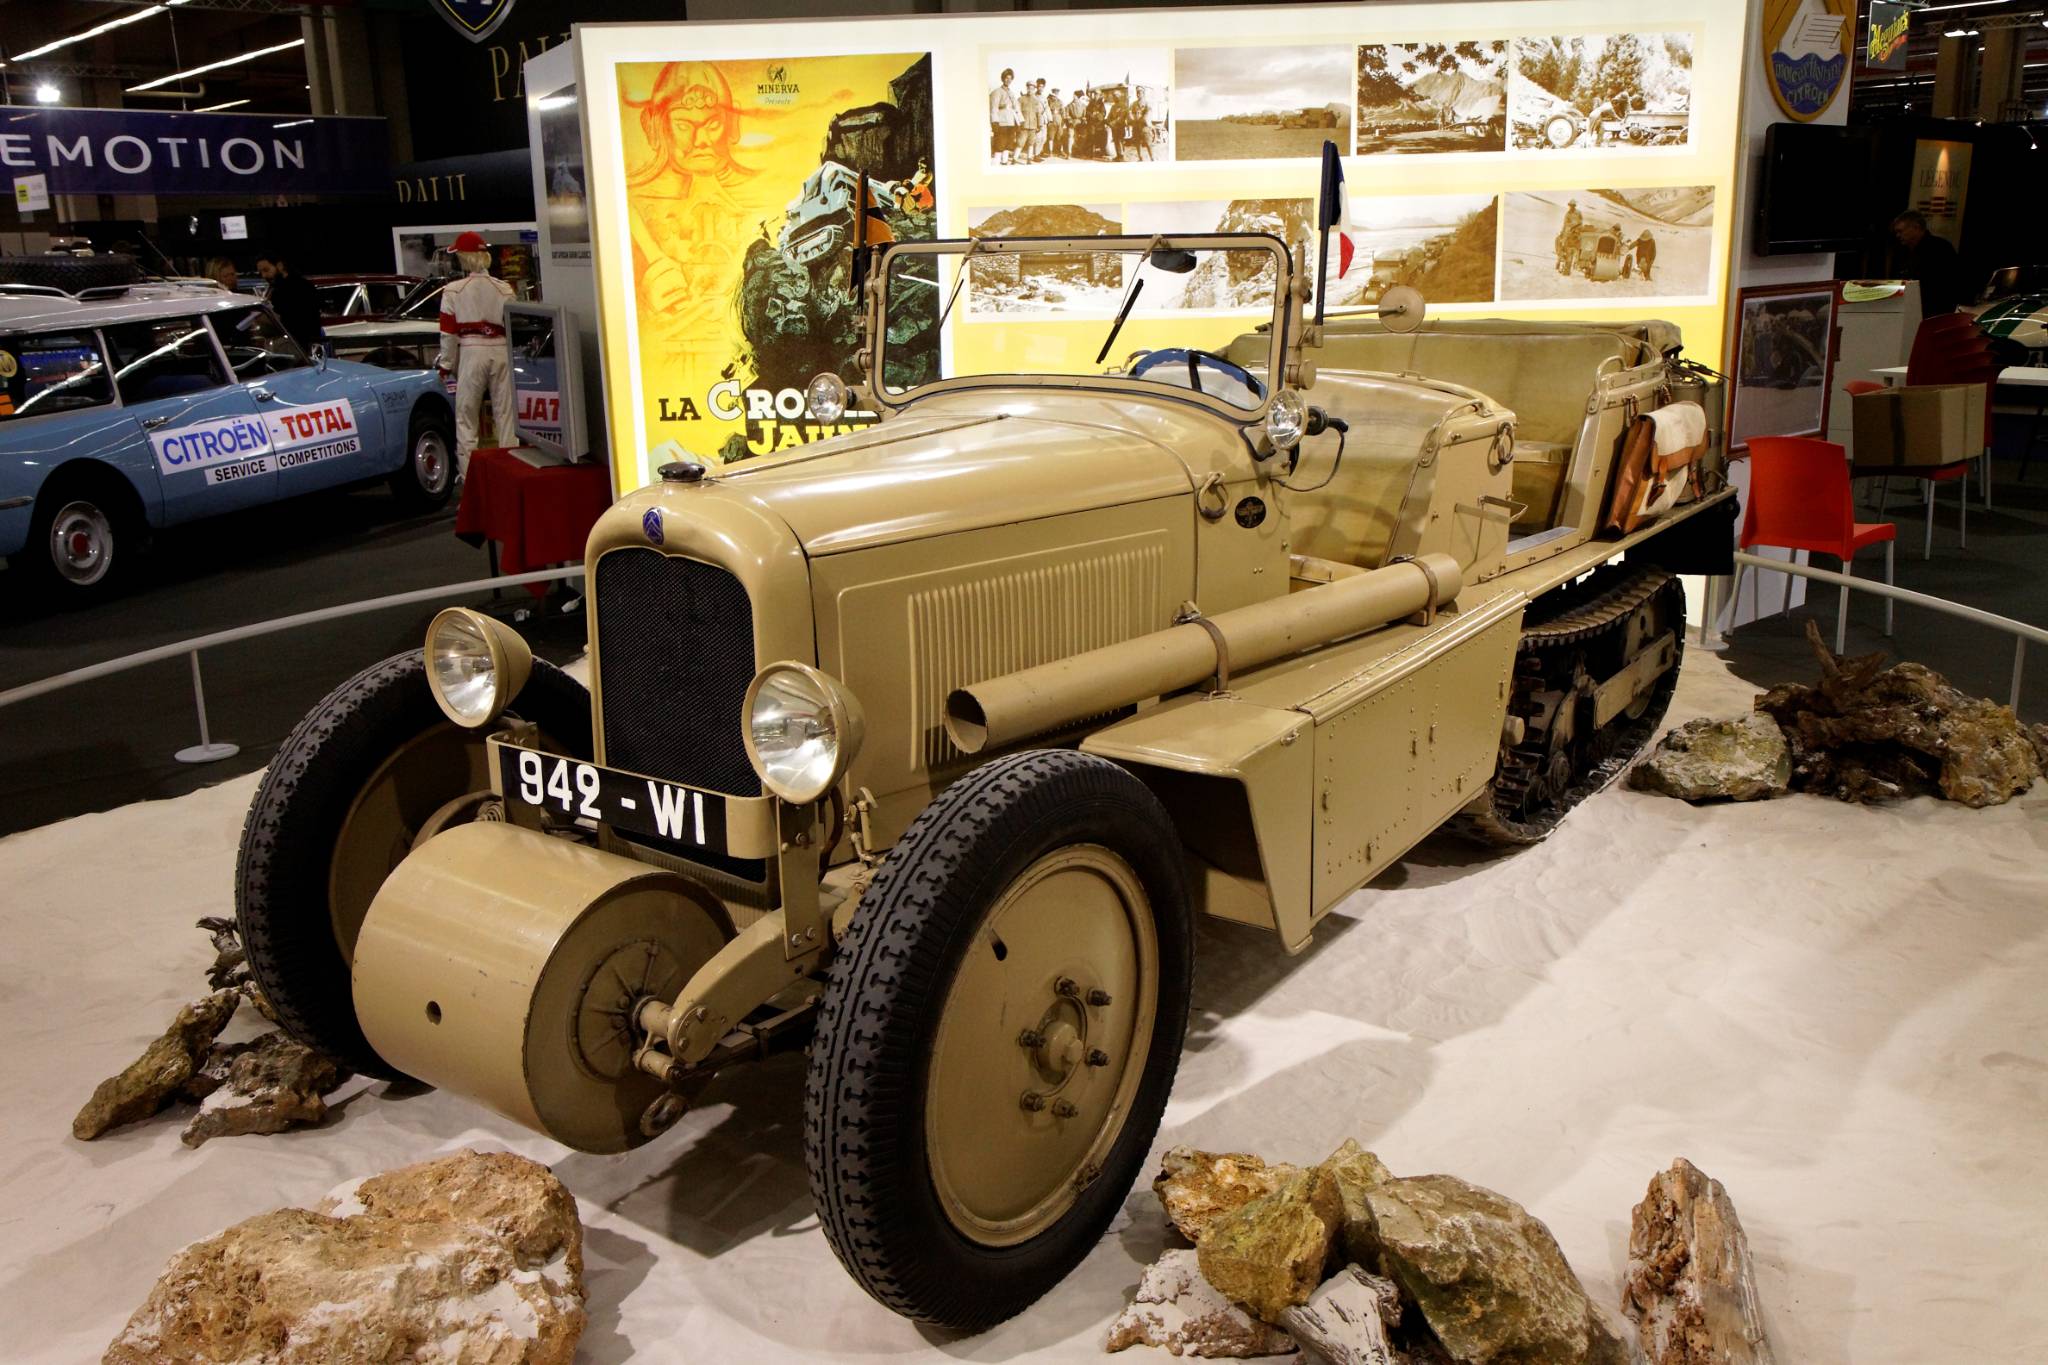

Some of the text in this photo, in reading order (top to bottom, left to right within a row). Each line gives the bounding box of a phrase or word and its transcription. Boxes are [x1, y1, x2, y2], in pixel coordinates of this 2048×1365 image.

[757, 84, 800, 94] MINERVA
[0, 134, 305, 175] EMOTION
[659, 398, 702, 421] LA
[163, 420, 268, 465] CITROËN
[281, 406, 352, 441] TOTAL
[215, 440, 357, 482] SERVICE COMPETITIONS
[519, 751, 601, 820] 942
[647, 780, 706, 845] WI
